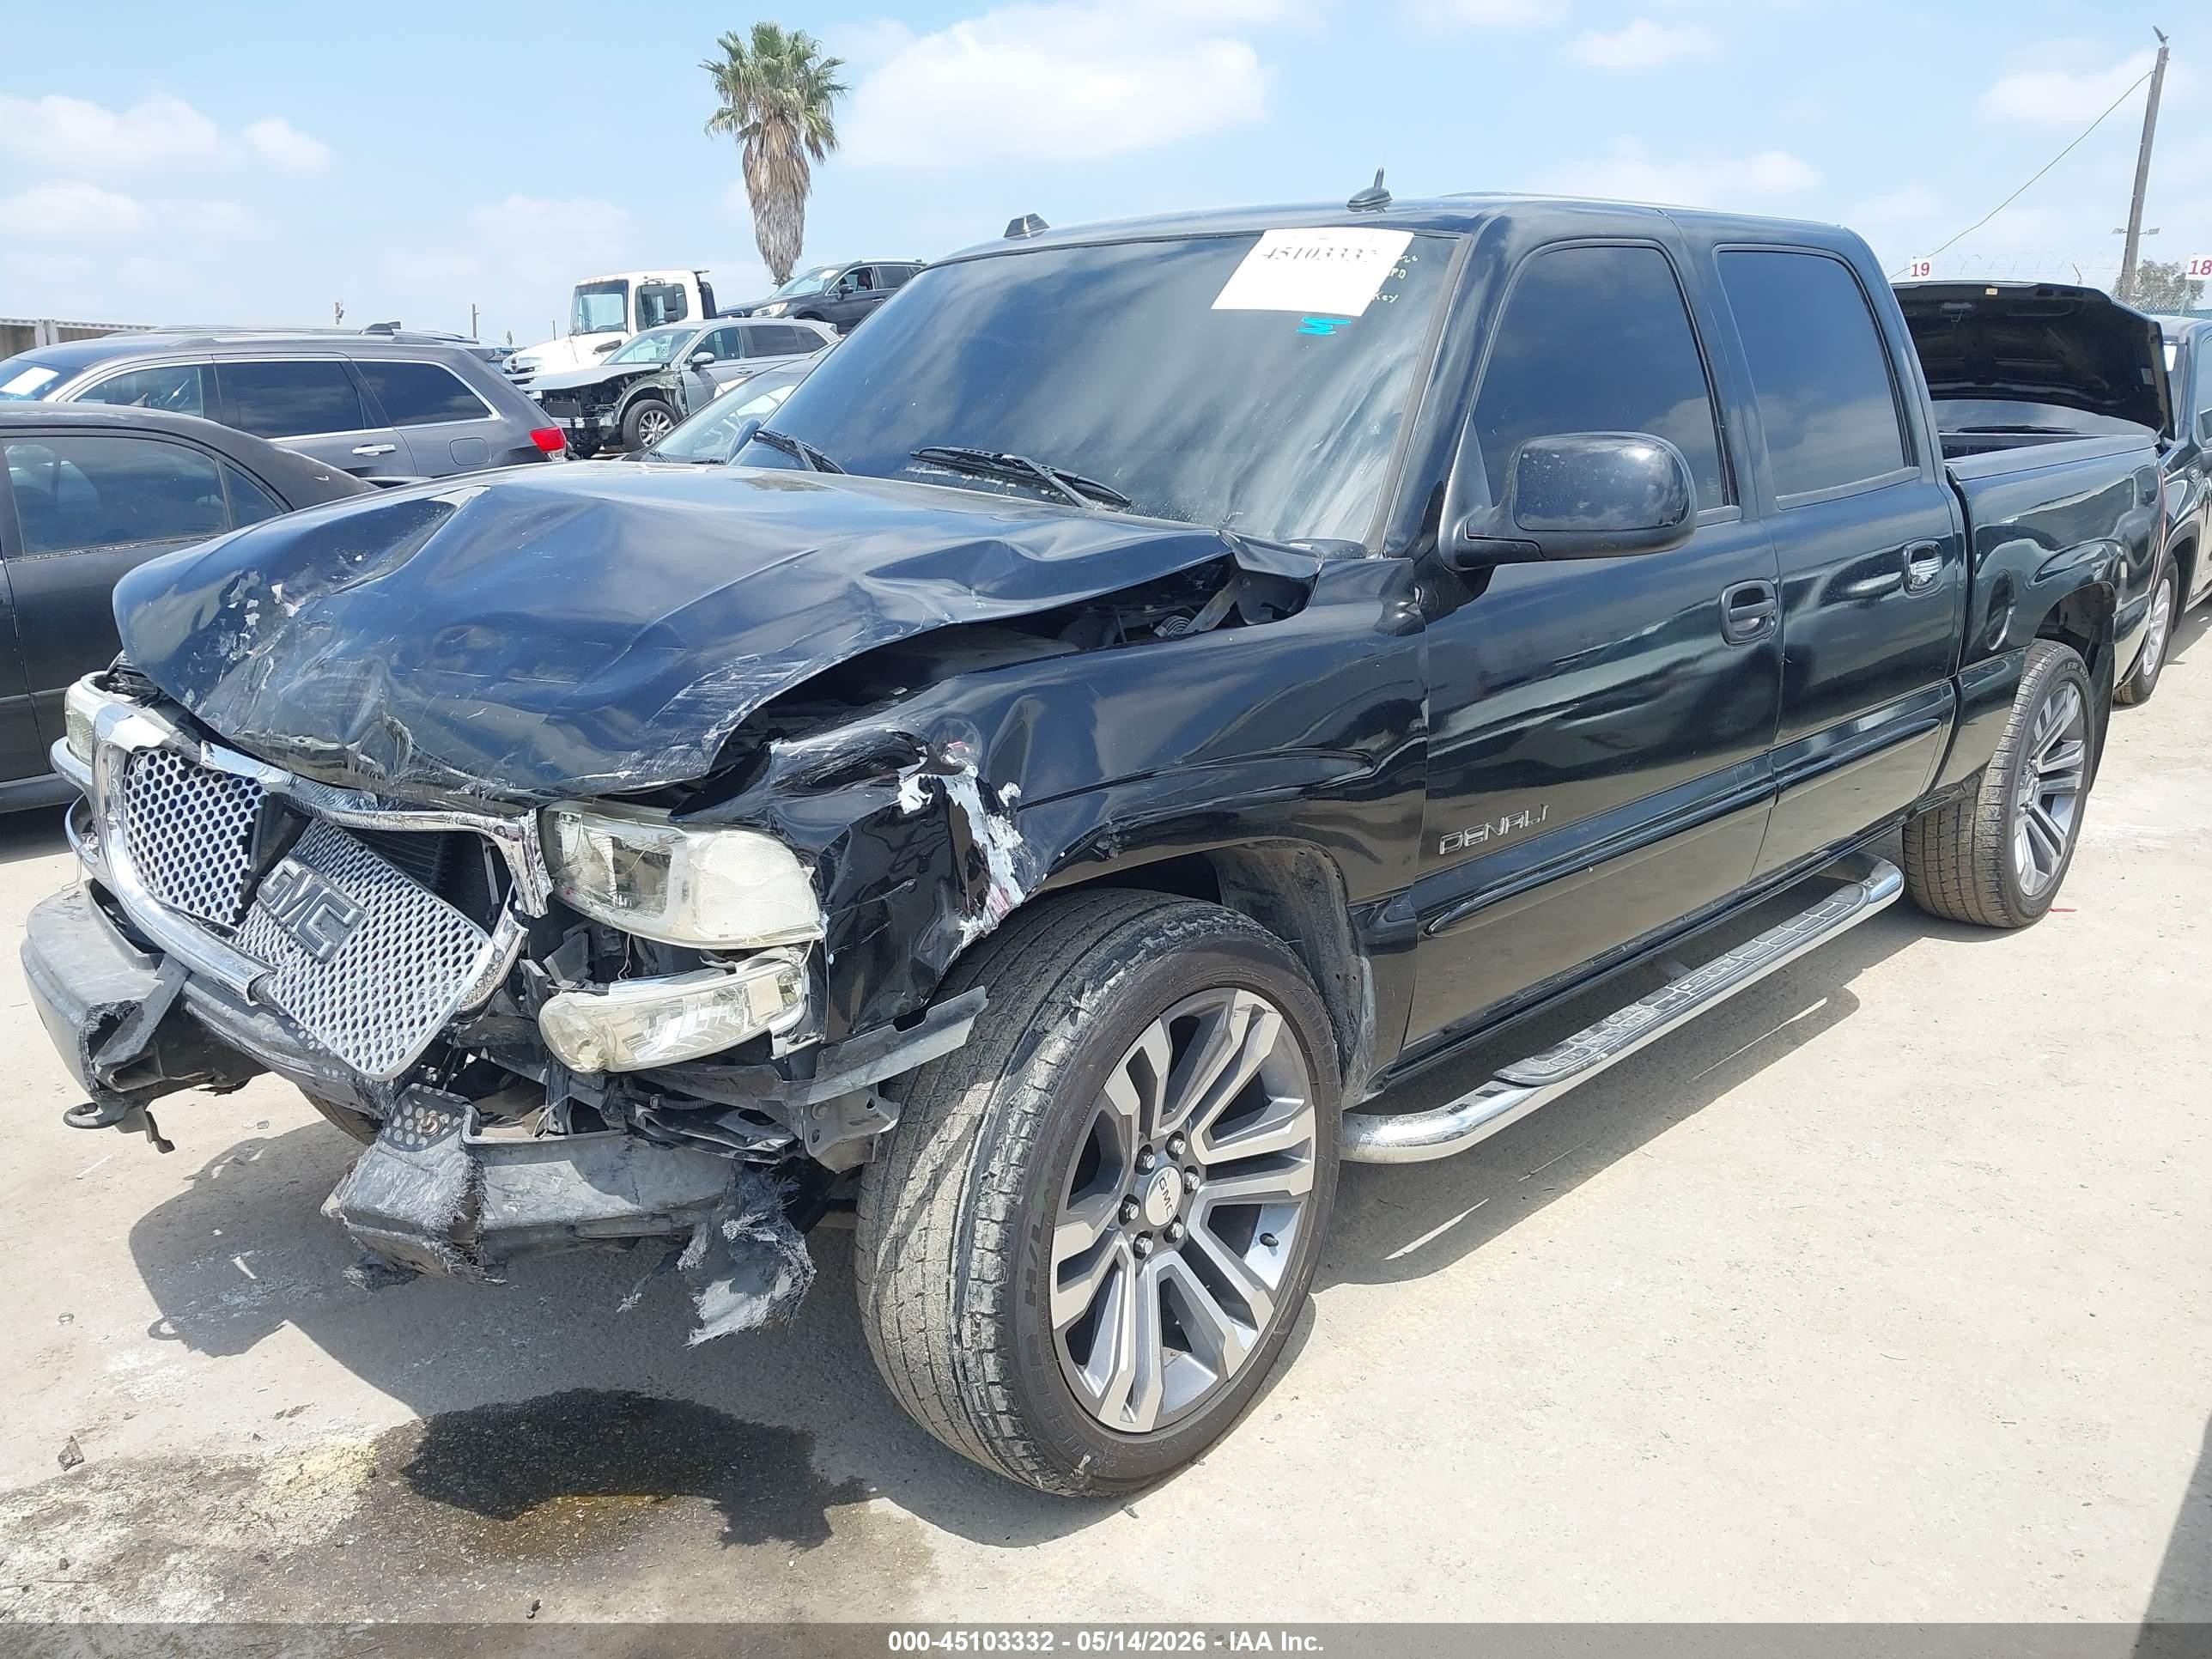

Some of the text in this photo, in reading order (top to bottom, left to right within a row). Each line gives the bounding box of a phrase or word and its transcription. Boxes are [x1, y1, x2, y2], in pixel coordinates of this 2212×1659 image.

[1910, 262, 1930, 277] 19
[2188, 259, 2212, 276] 18
[1439, 804, 1549, 855] DENALI
[257, 857, 368, 962] GMC
[1158, 1176, 1175, 1218] GMC
